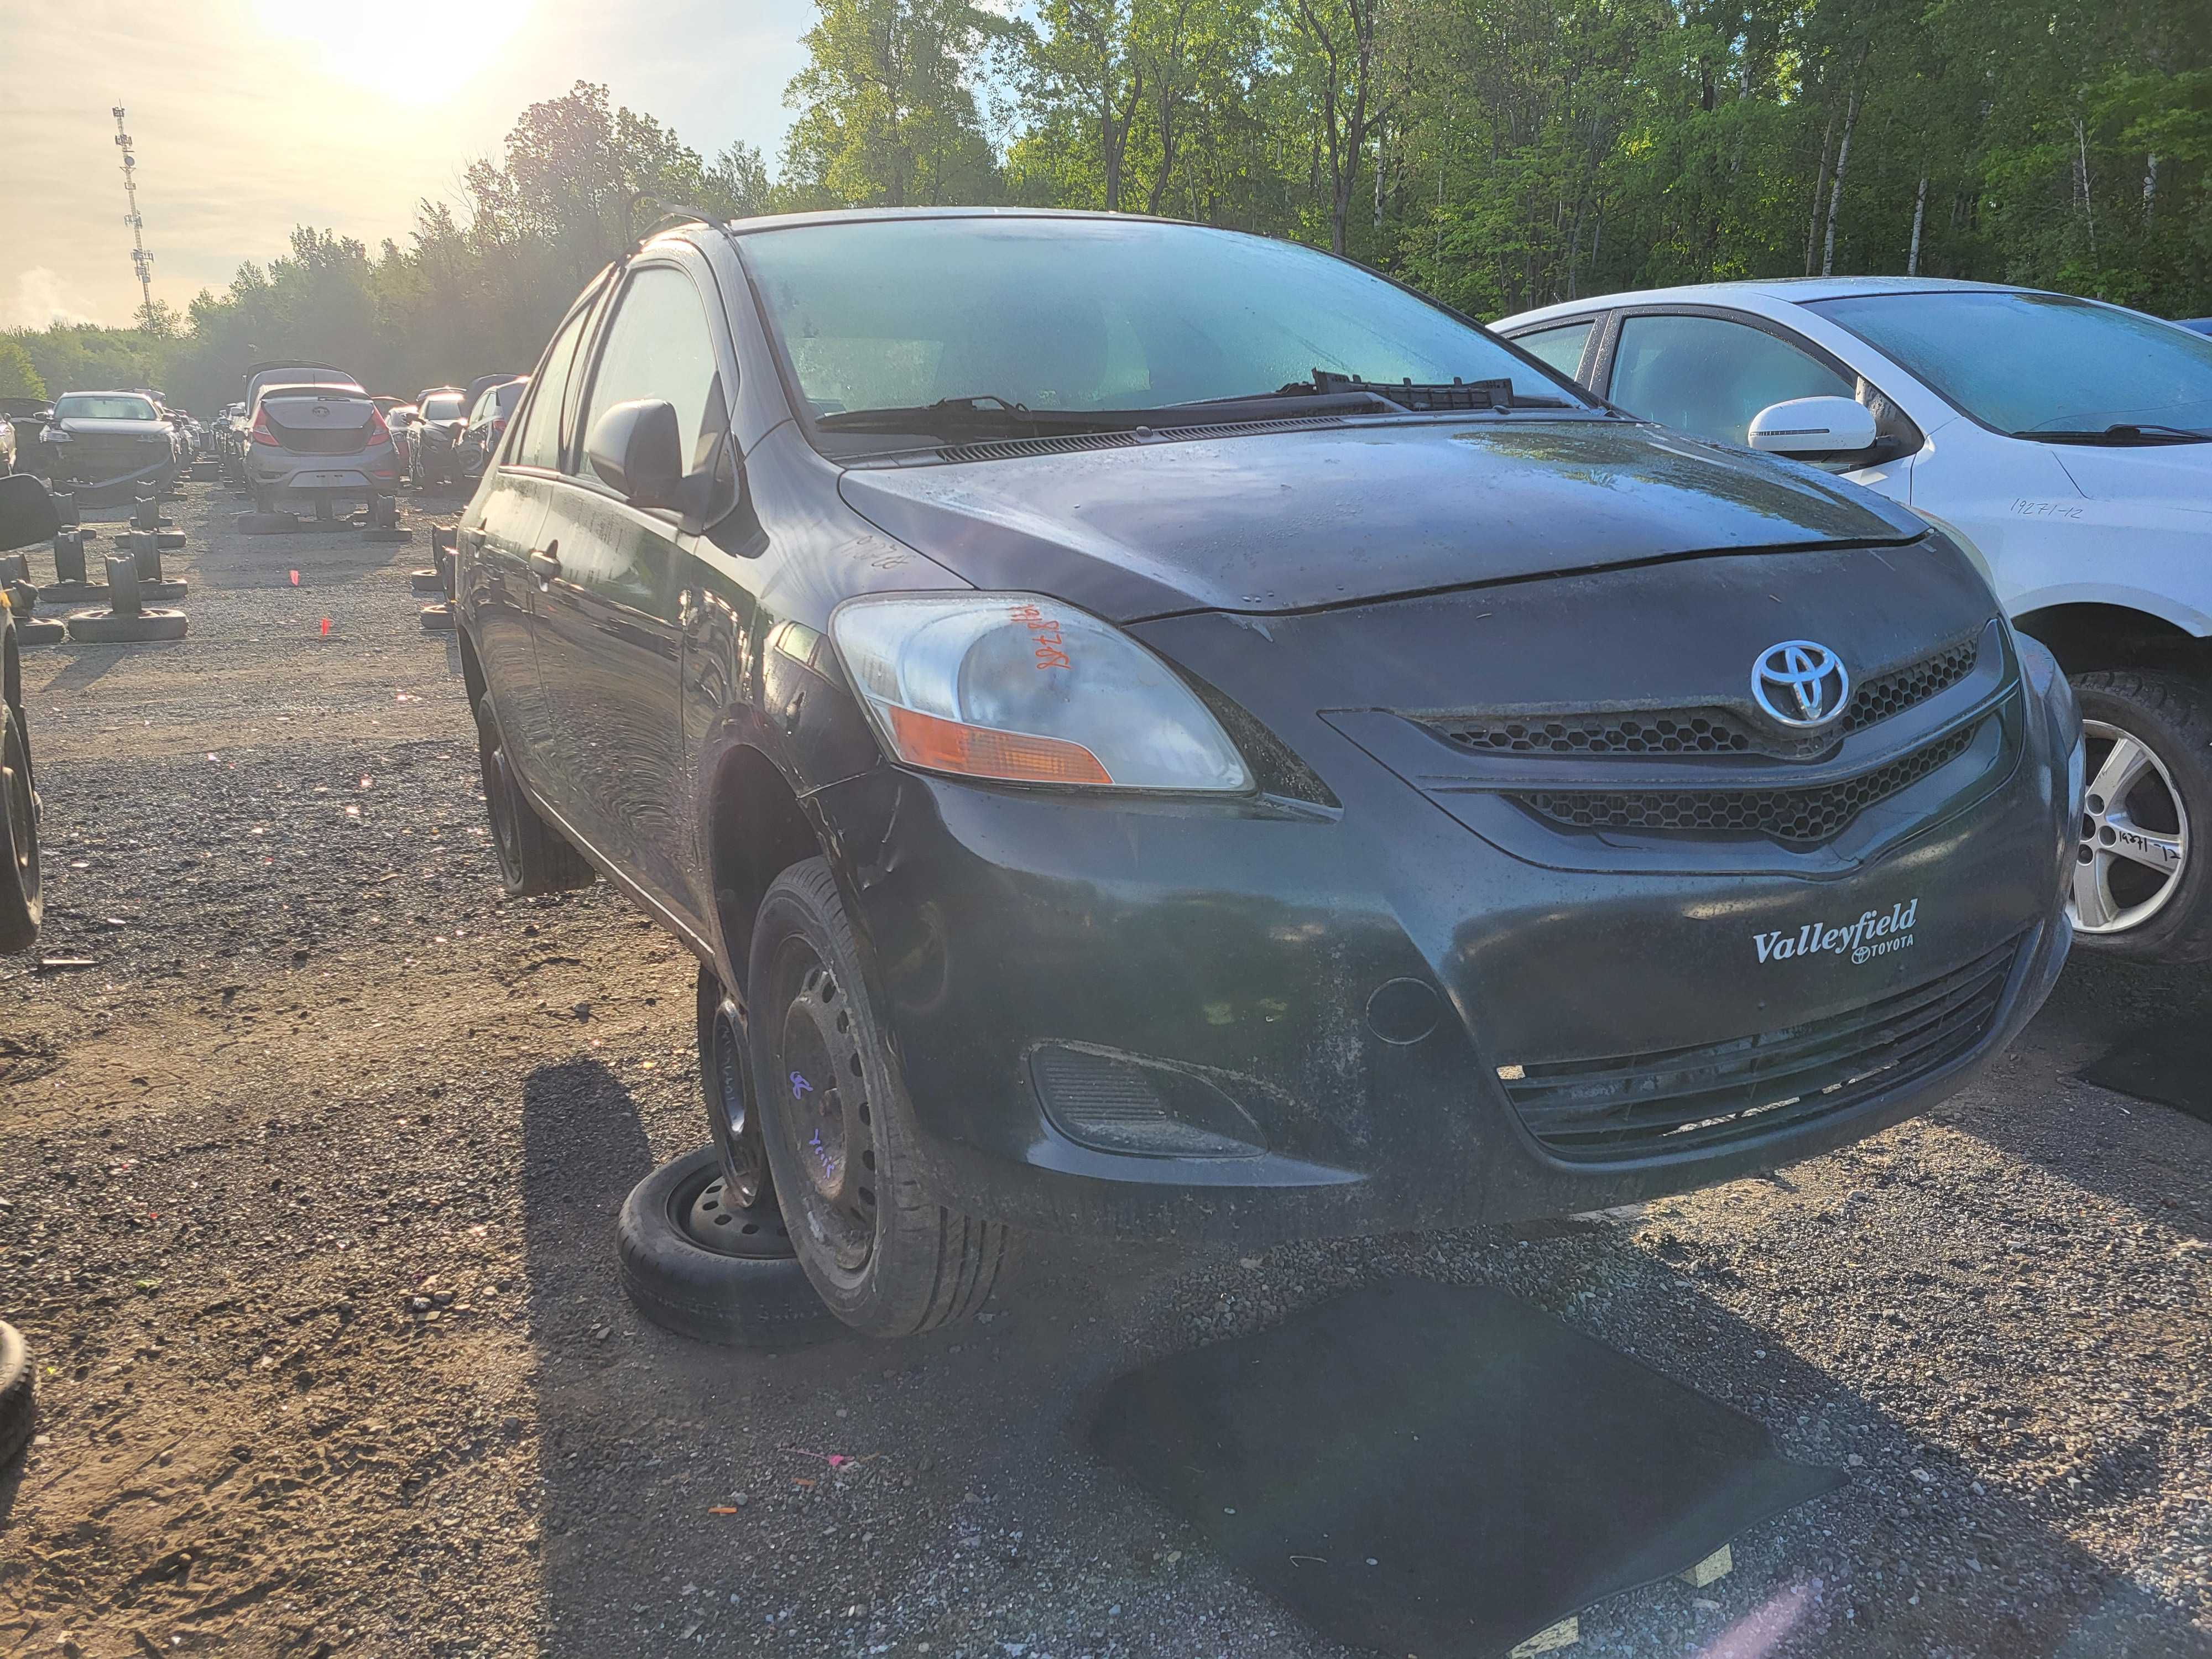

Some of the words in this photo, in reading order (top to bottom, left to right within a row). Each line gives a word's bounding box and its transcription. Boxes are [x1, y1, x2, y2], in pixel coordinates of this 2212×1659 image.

[2011, 498, 2083, 519] 19271-12
[1753, 898, 1919, 964] Valleyfield
[1871, 934, 1914, 957] TOYOTA
